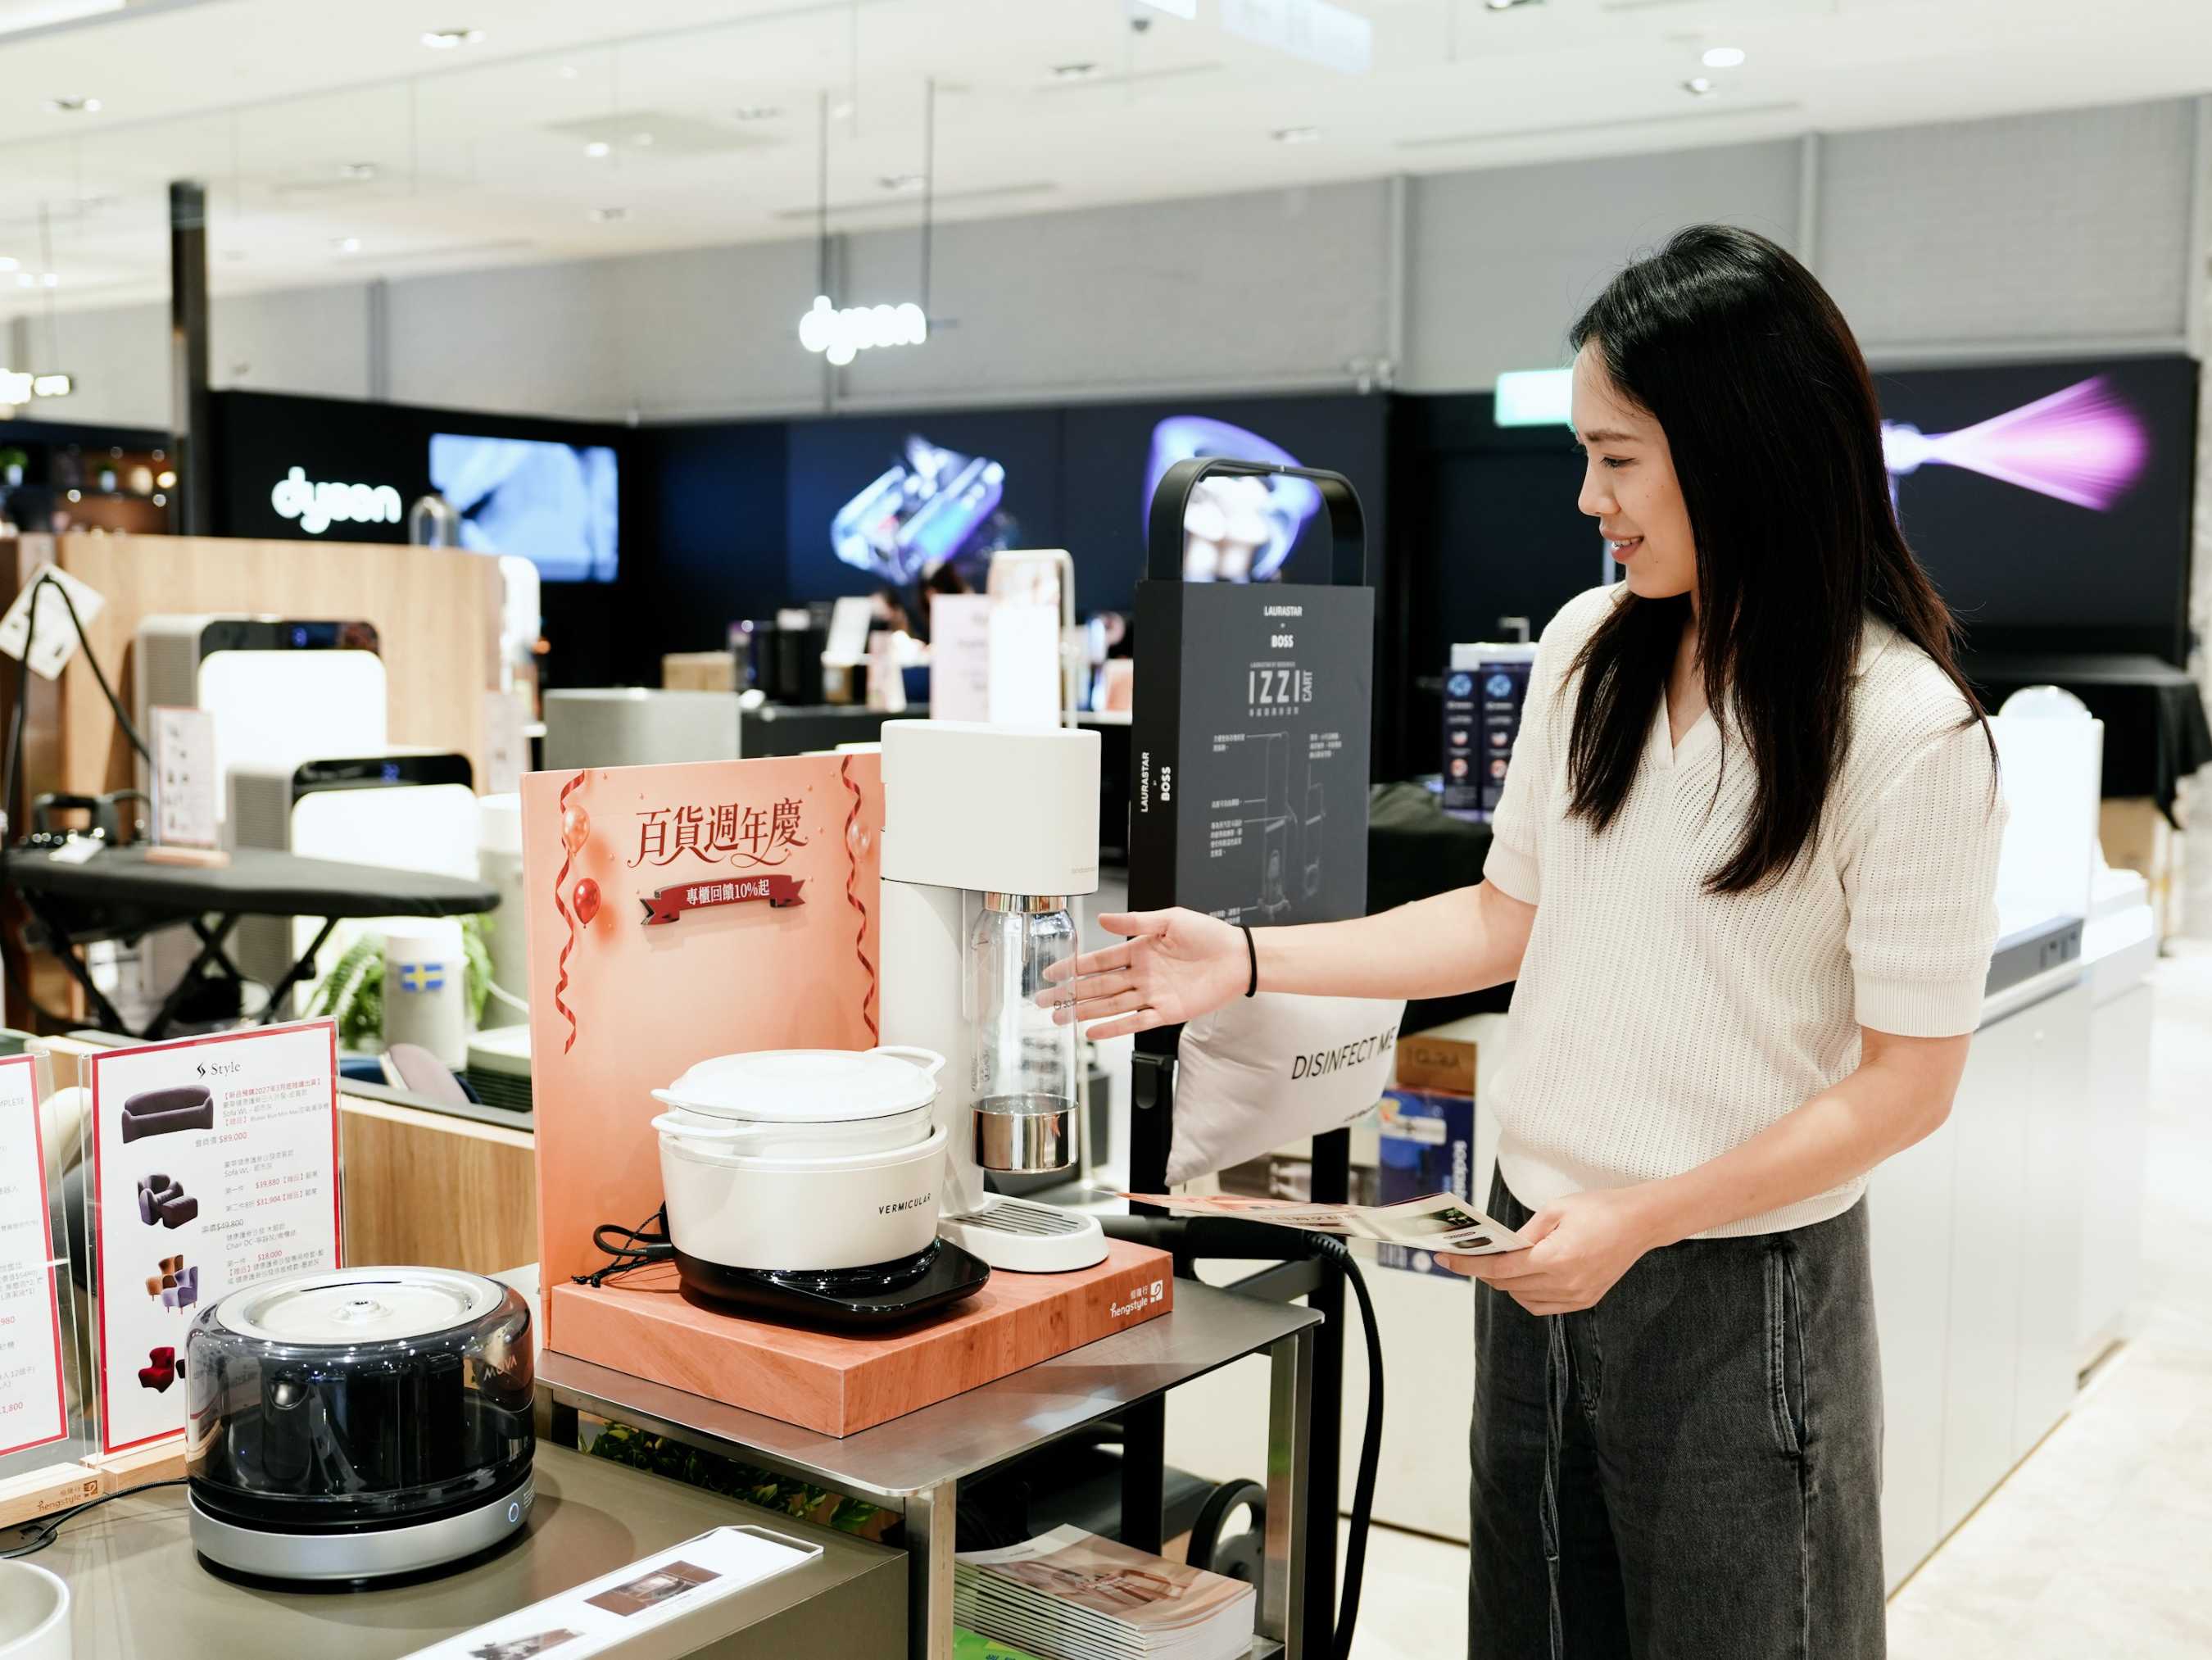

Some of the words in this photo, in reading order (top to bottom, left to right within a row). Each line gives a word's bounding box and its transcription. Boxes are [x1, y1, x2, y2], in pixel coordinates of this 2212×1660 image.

[1263, 605, 1303, 617] LAURASTAR
[1271, 634, 1294, 648] BOSS
[1249, 669, 1301, 705] IZZI
[1303, 670, 1312, 702] CART
[1140, 751, 1149, 813] LAURASTAR
[1160, 766, 1171, 801] BOSS
[627, 796, 809, 869] 百貨週年慶
[687, 878, 771, 905] 專櫃回饋10%起
[1291, 1036, 1378, 1080] DISINFECT
[1377, 1026, 1398, 1056] ME
[210, 1062, 241, 1077] Style
[878, 1192, 931, 1214] VERMICULAR
[1110, 1297, 1148, 1318] hengstyle
[483, 1354, 517, 1381] MOVA
[38, 1494, 81, 1512] hengstyle
